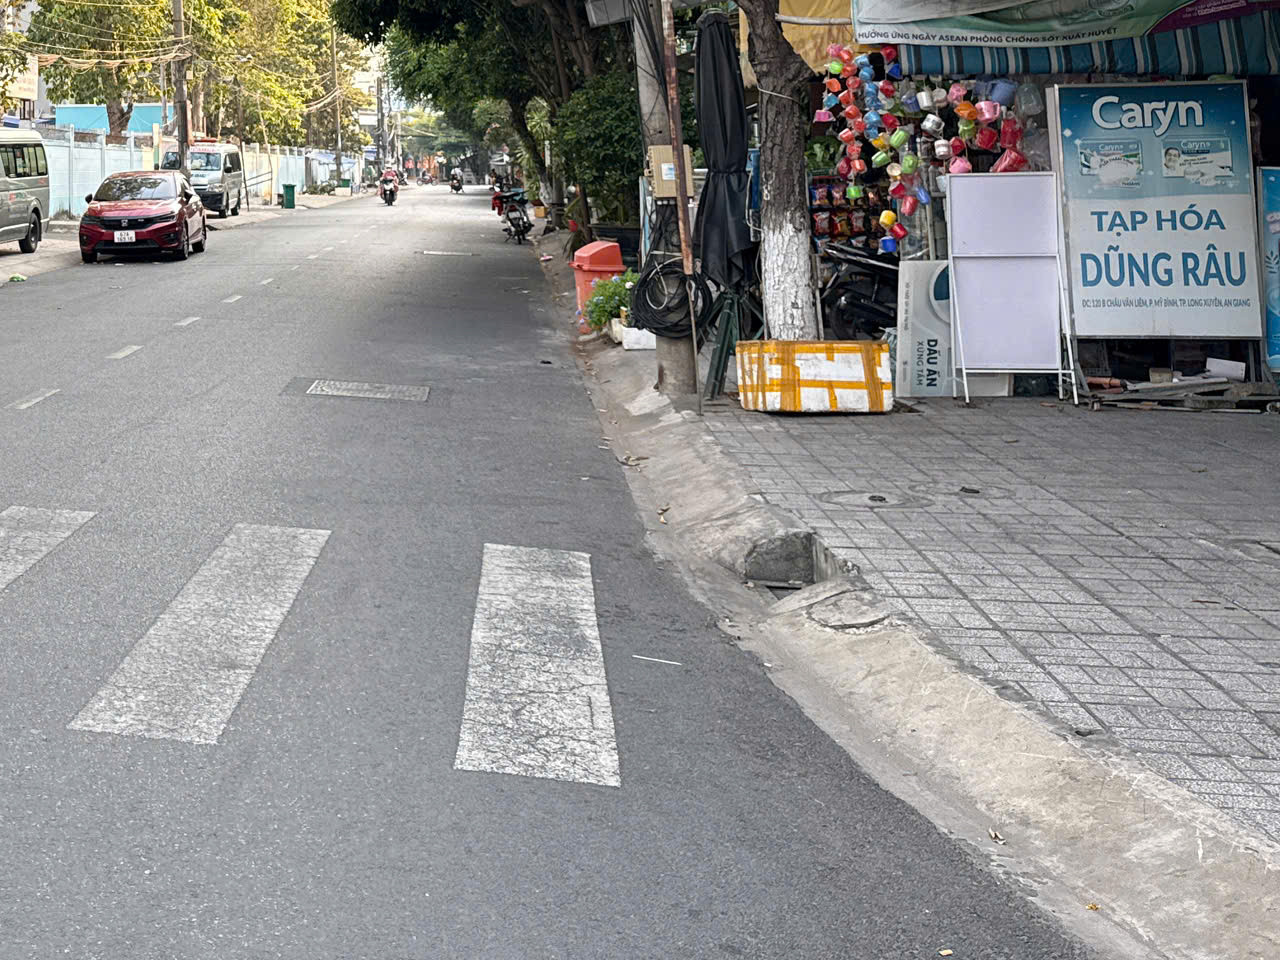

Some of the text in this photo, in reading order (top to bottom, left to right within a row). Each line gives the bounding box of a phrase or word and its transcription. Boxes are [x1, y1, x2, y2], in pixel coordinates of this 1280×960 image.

[938, 34, 968, 42] ASEAN
[1091, 95, 1204, 137] Caryn
[1090, 203, 1227, 237] TẠP HÓA
[1080, 243, 1247, 288] DŨNG RÂU
[1187, 298, 1203, 308] LONG
[1223, 298, 1232, 308] AN
[1232, 298, 1251, 308] GIANG
